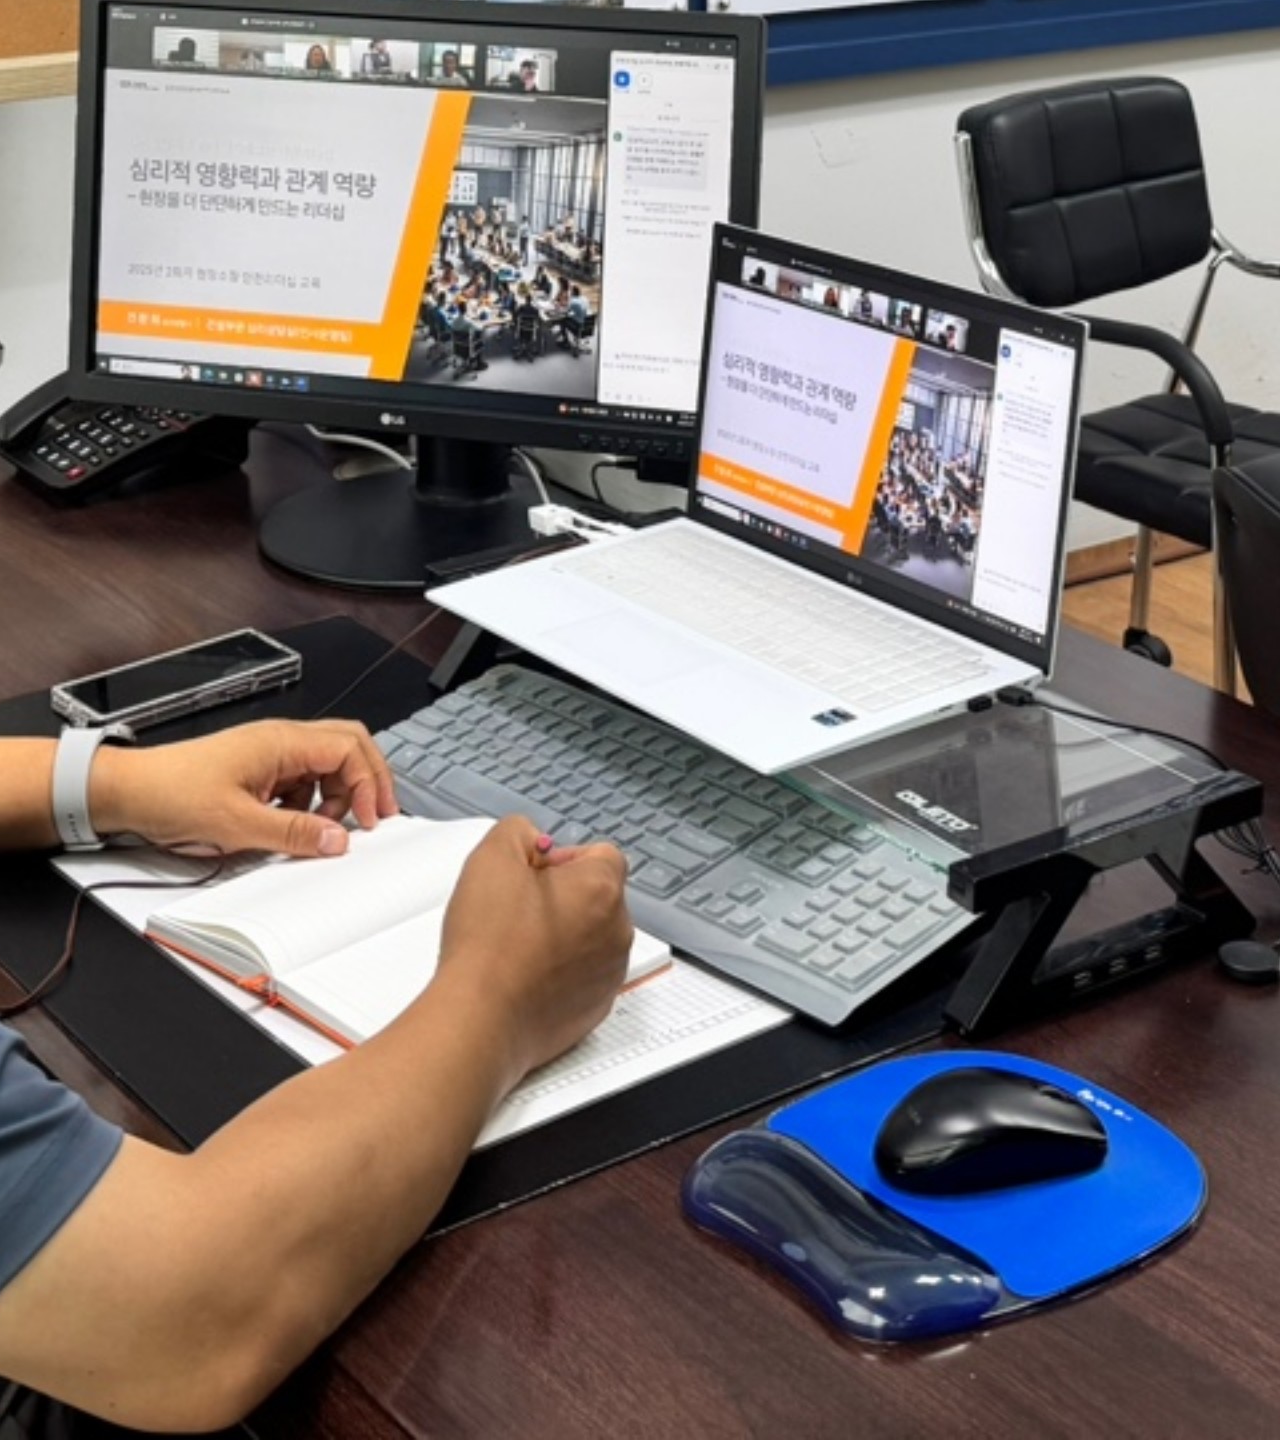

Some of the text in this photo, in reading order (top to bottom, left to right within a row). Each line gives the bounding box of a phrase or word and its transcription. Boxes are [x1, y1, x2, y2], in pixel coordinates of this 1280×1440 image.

[130, 157, 376, 200] 심리적 영향력과 관계 역량
[140, 189, 180, 210] 현장을
[183, 193, 196, 211] 더
[303, 201, 345, 222] 리더십
[723, 351, 755, 377] 심리적
[806, 377, 830, 402] 관계
